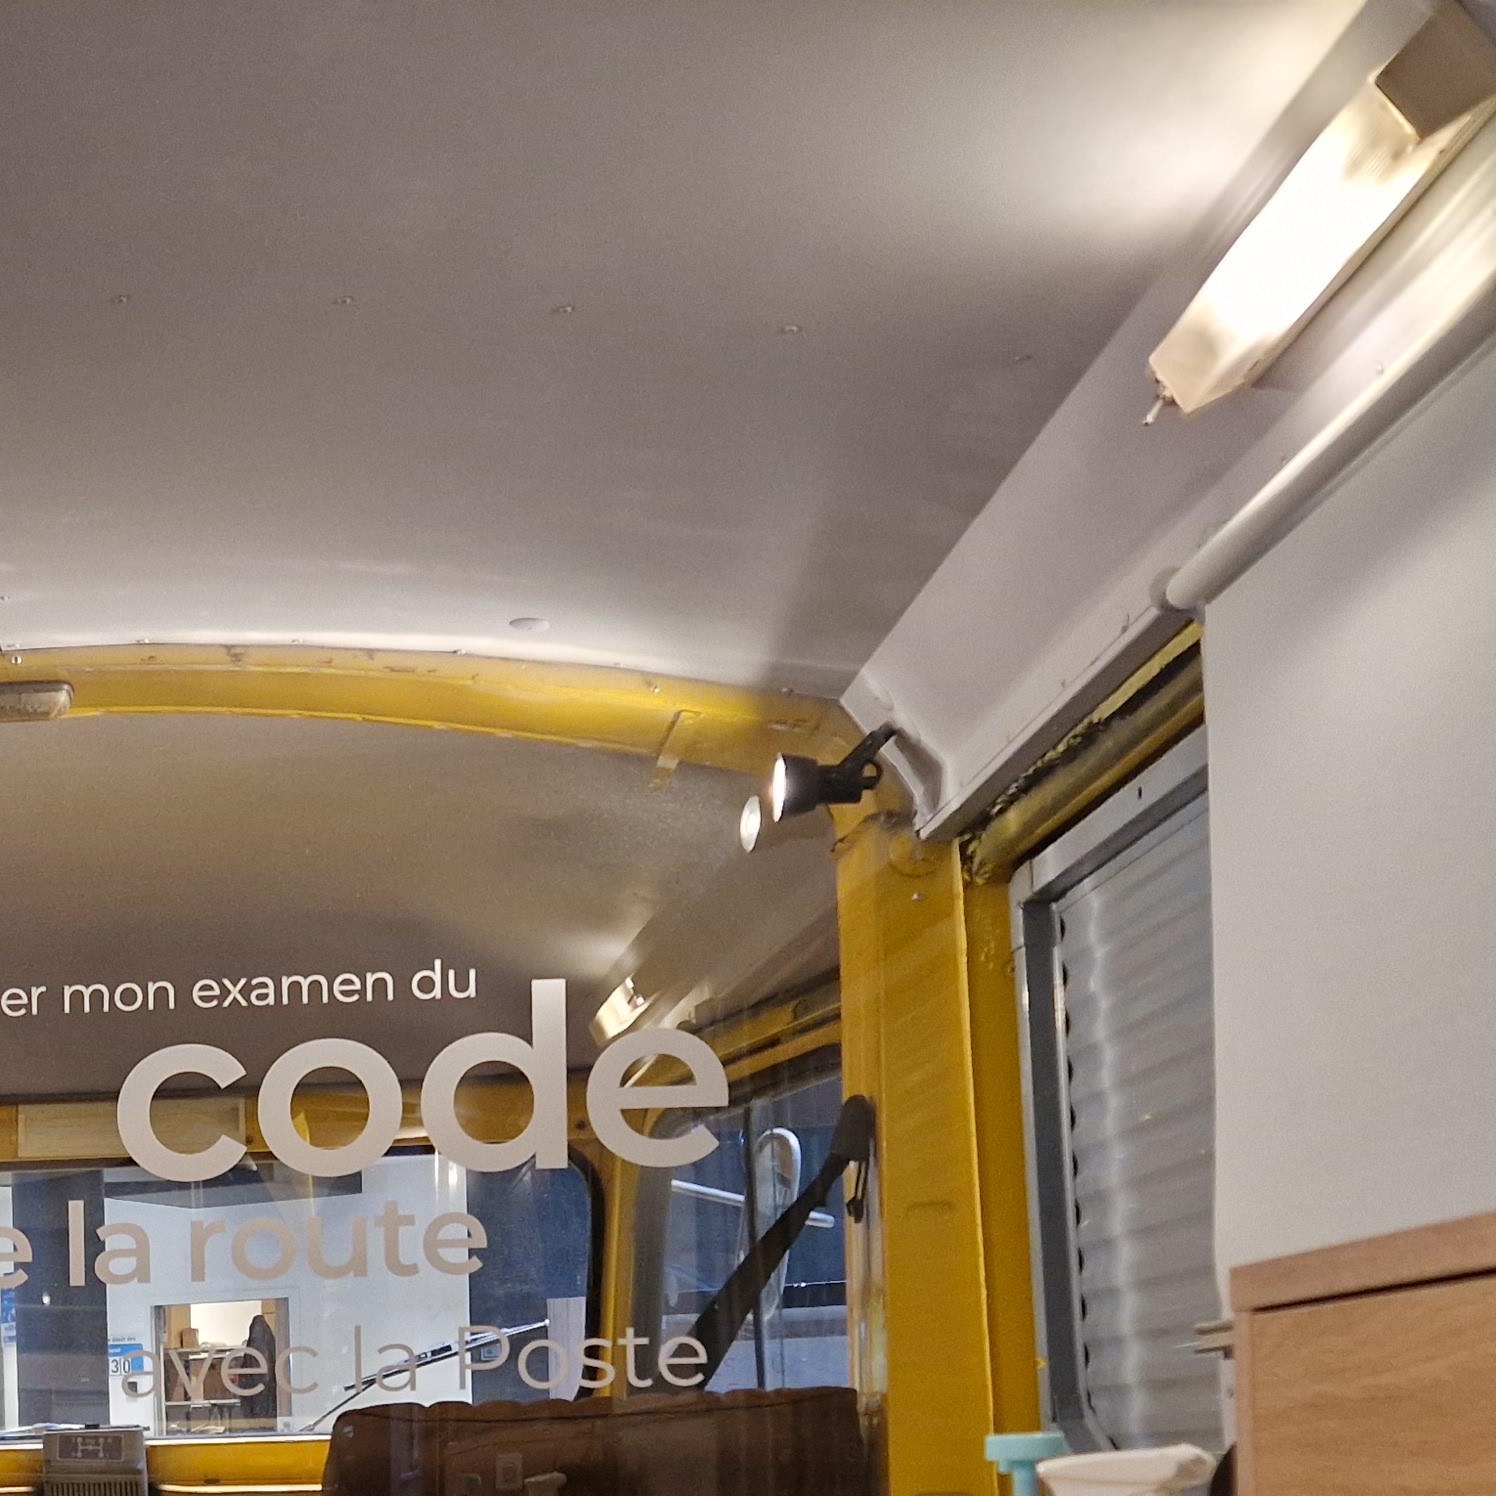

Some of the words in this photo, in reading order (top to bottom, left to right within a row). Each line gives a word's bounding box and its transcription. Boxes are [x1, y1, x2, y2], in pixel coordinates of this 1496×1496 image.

[62, 981, 177, 1014] mon
[191, 972, 397, 1010] examen
[410, 958, 478, 1001] du
[116, 978, 729, 1182] code
[68, 1199, 151, 1287] la
[189, 1199, 488, 1284] route
[122, 1338, 320, 1398] avec
[355, 1324, 416, 1393] la
[457, 1323, 708, 1392] Poste
